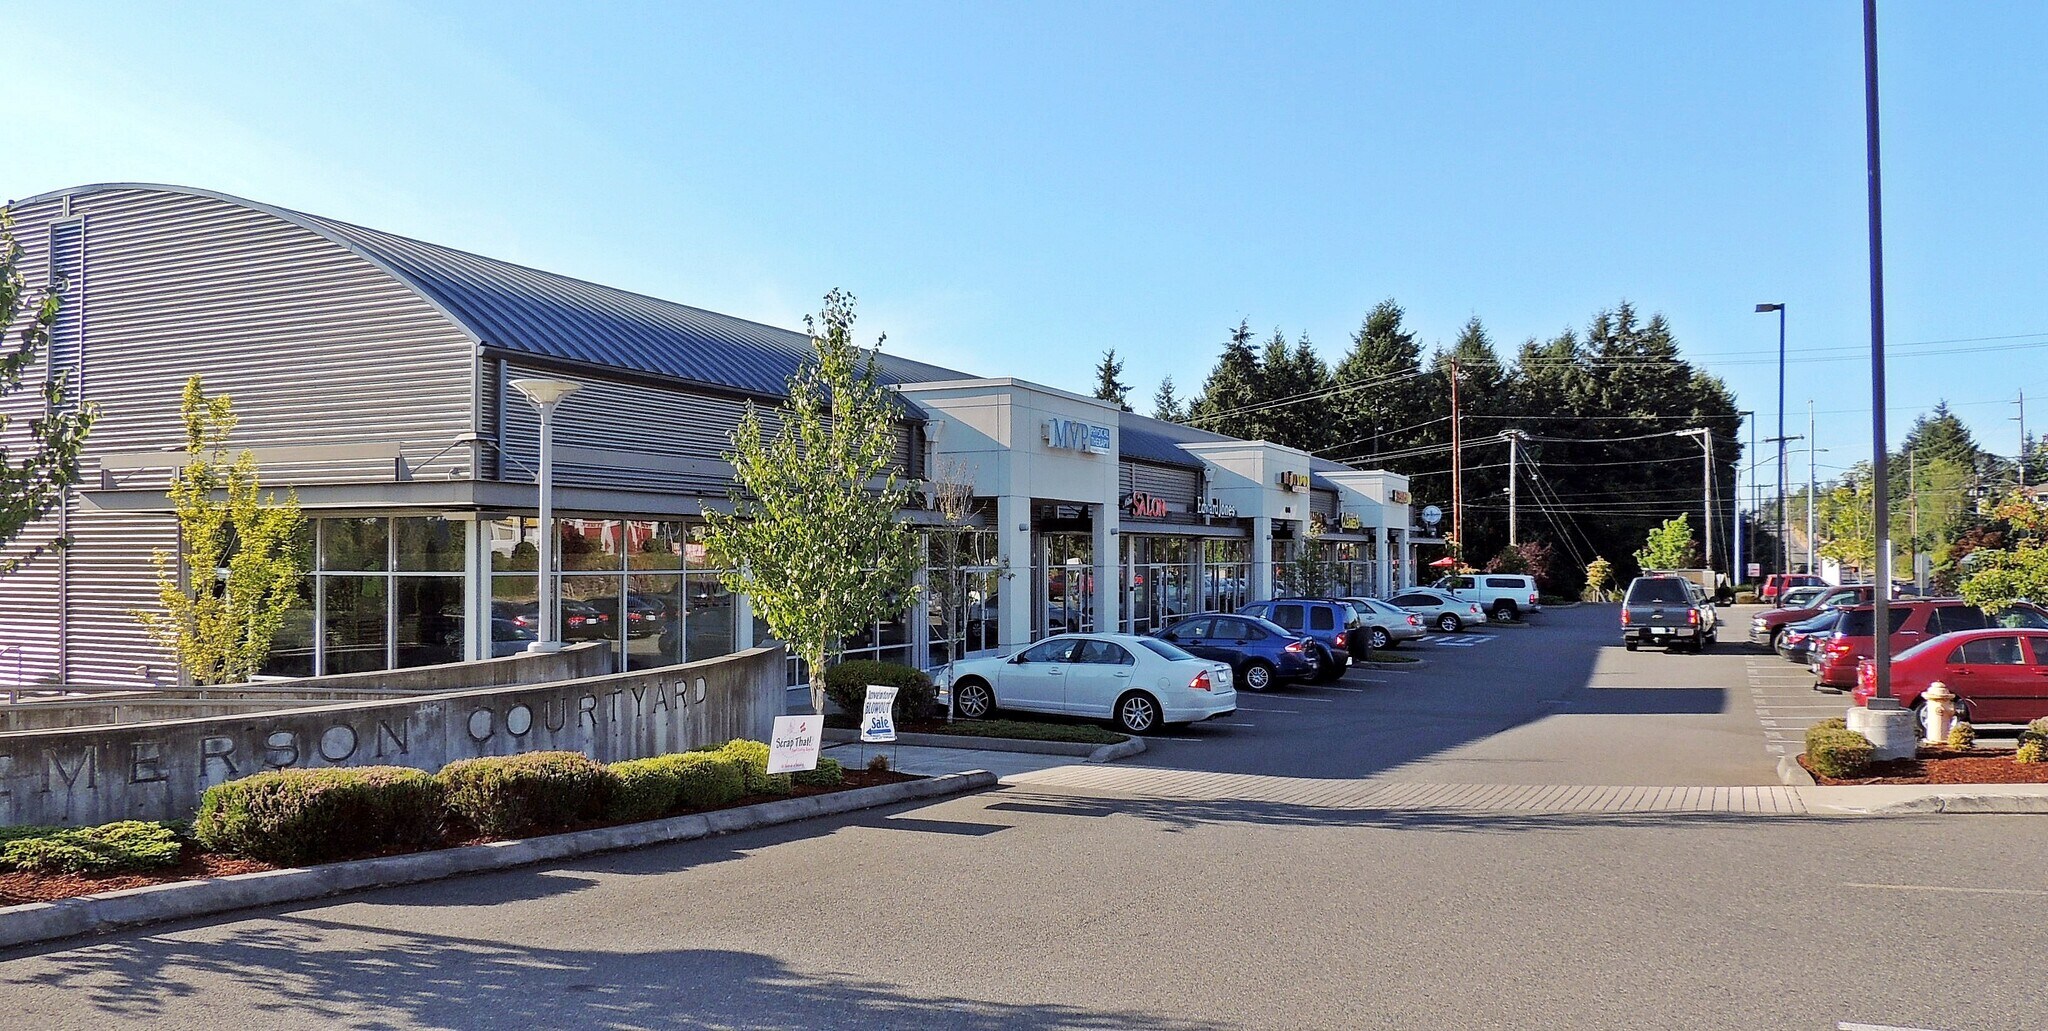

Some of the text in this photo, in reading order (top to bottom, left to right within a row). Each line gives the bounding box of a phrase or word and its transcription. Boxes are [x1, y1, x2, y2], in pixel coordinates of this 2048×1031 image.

[1049, 418, 1089, 451] MVP
[1132, 491, 1167, 517] SALON
[1197, 496, 1236, 518] Edward Jones
[868, 690, 895, 699] Inventory
[865, 702, 891, 714] BLOWOUT
[871, 717, 889, 729] Sale
[0, 675, 707, 796] MERSON COURTYARD
[776, 736, 811, 749] Scrap That!
